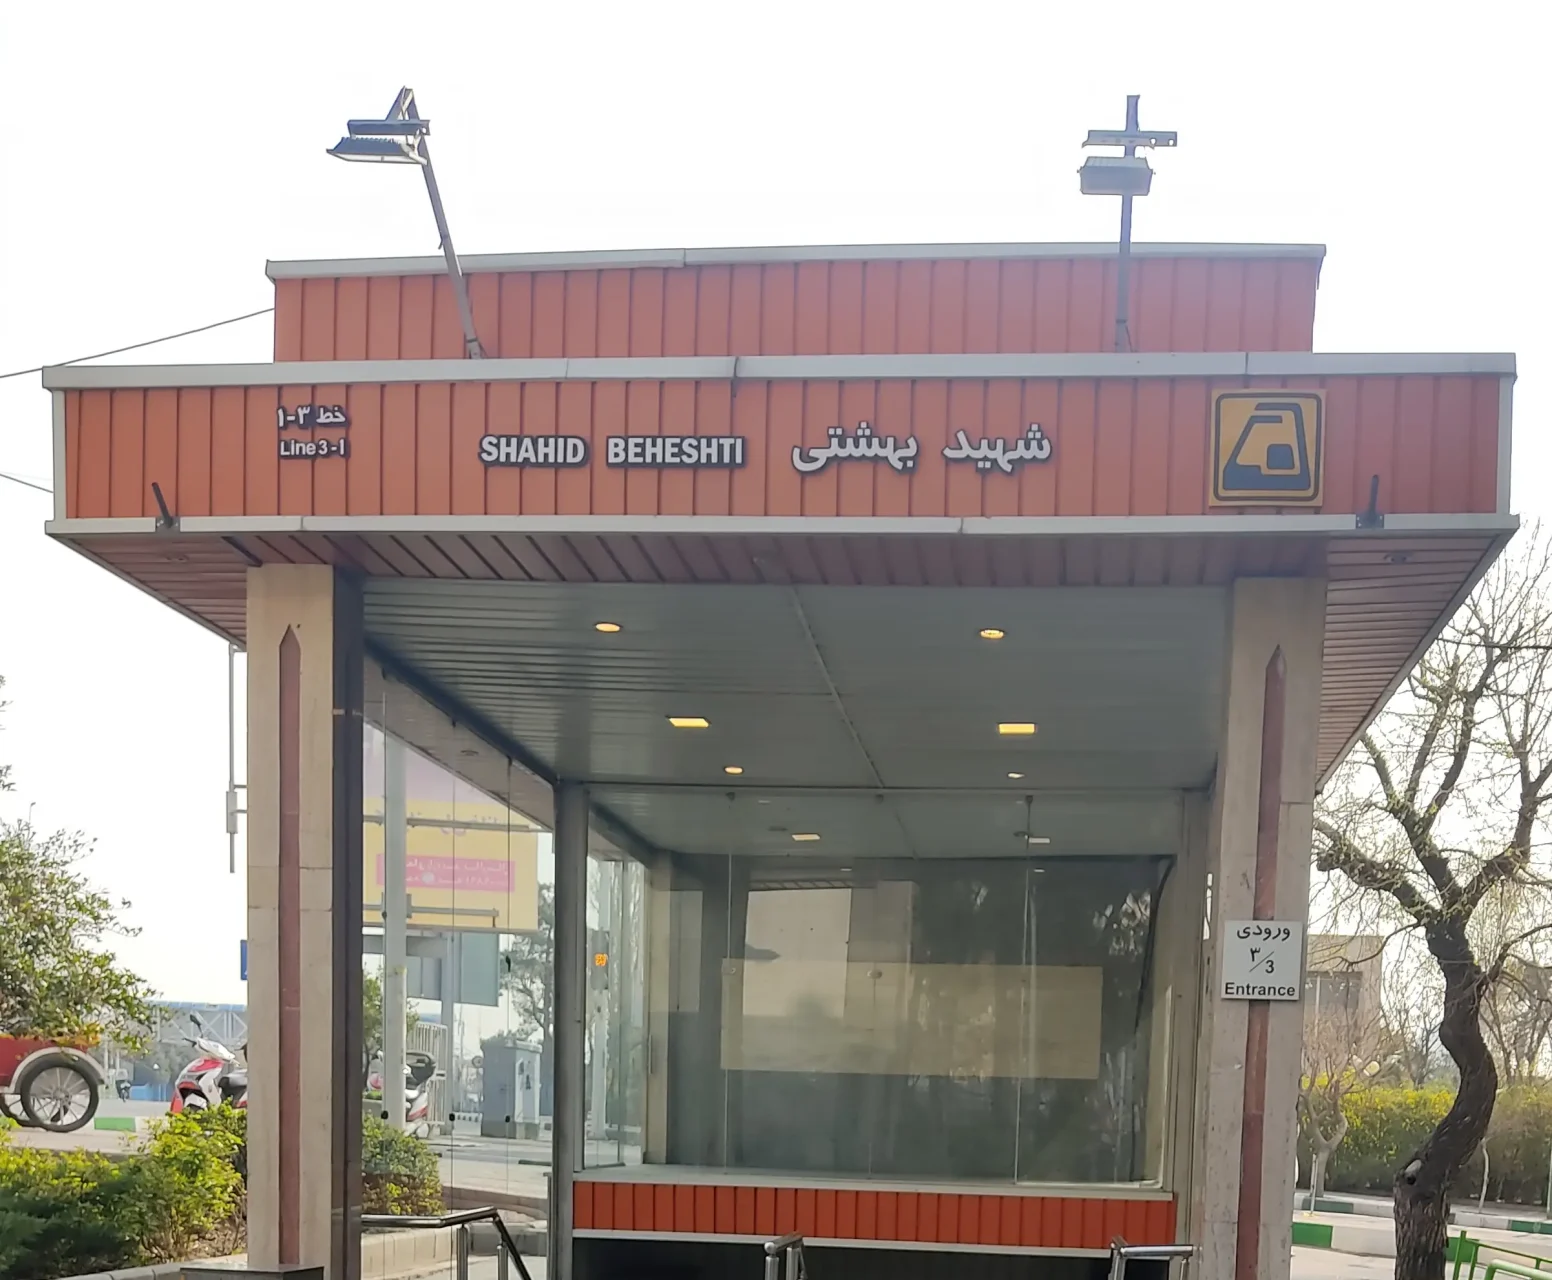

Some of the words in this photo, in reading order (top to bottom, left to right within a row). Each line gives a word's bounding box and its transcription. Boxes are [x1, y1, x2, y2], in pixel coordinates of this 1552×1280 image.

[316, 406, 346, 423] خط
[280, 439, 317, 455] Line
[481, 436, 585, 463] SHAHID
[608, 438, 743, 464] BEHESHTI
[791, 421, 917, 472] بهشتی
[942, 423, 1051, 472] شهید
[1237, 925, 1291, 941] ورودی
[1225, 982, 1296, 997] Entrance
